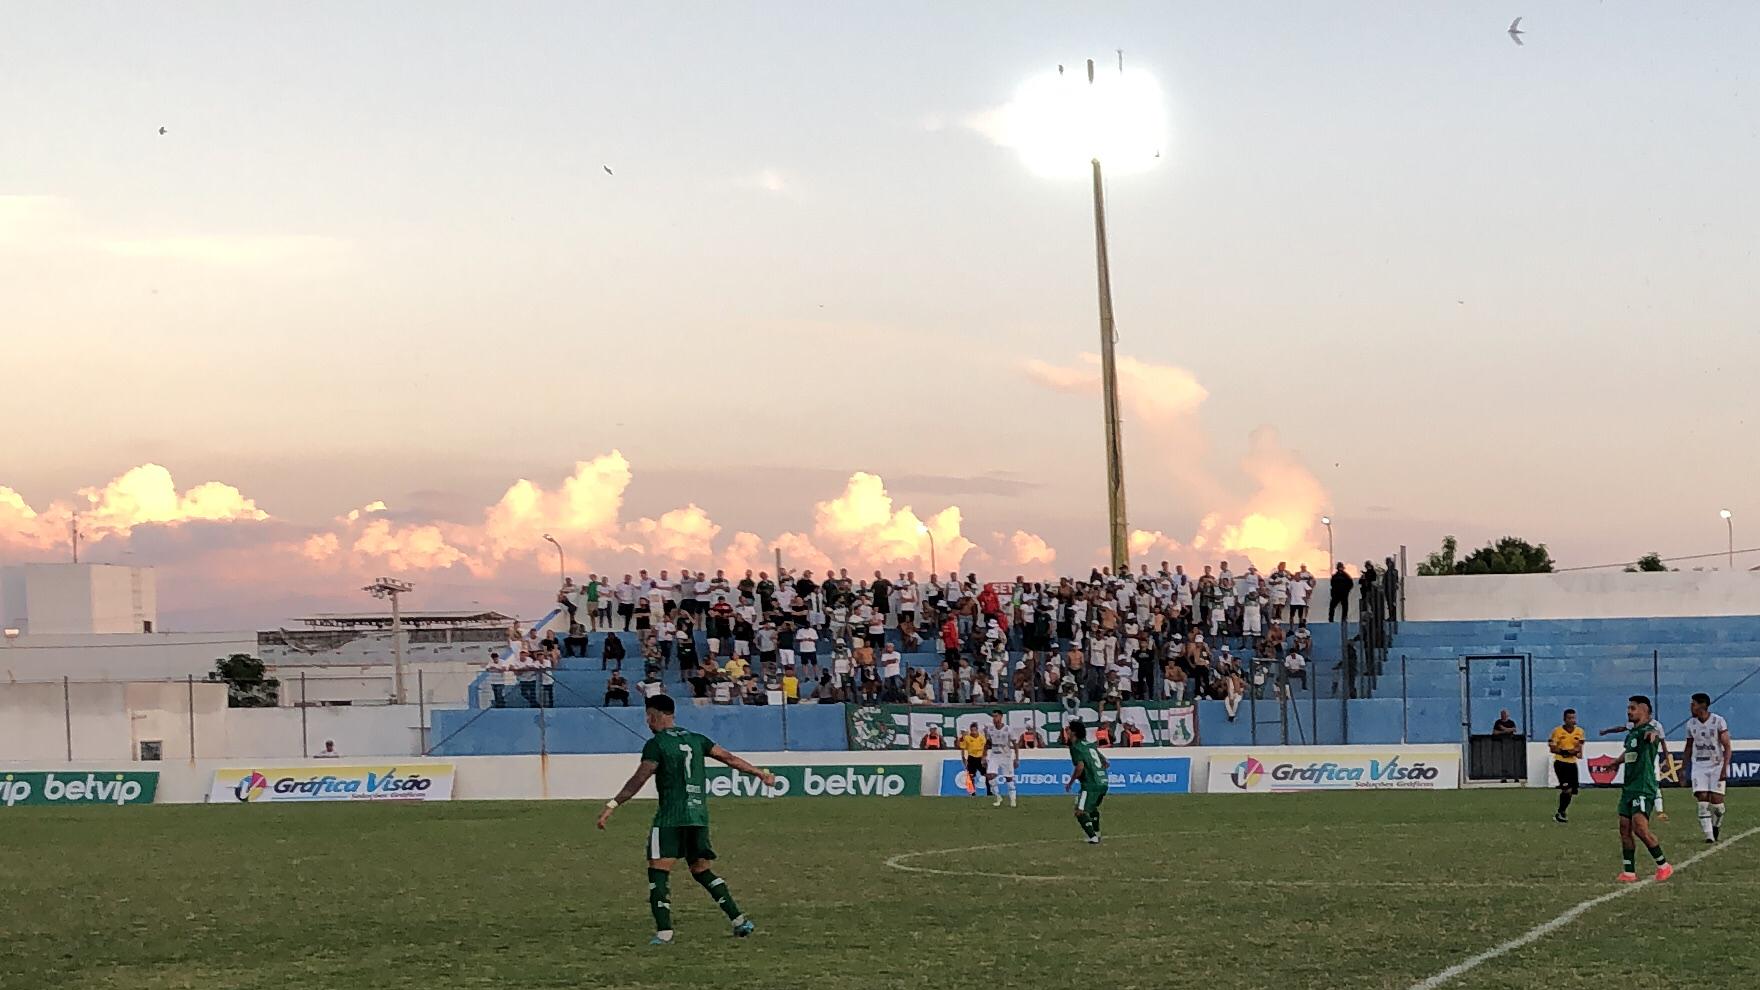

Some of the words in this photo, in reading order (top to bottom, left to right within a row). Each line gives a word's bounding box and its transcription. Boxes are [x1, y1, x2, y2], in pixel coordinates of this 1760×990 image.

[678, 743, 693, 779] 7
[1088, 747, 1103, 769] 9
[1272, 762, 1365, 784] Gráfica
[1370, 755, 1439, 781] Visão
[44, 773, 142, 806] betvip
[273, 775, 359, 796] Gráfica
[365, 767, 432, 792] Visão
[804, 767, 905, 798] betvip
